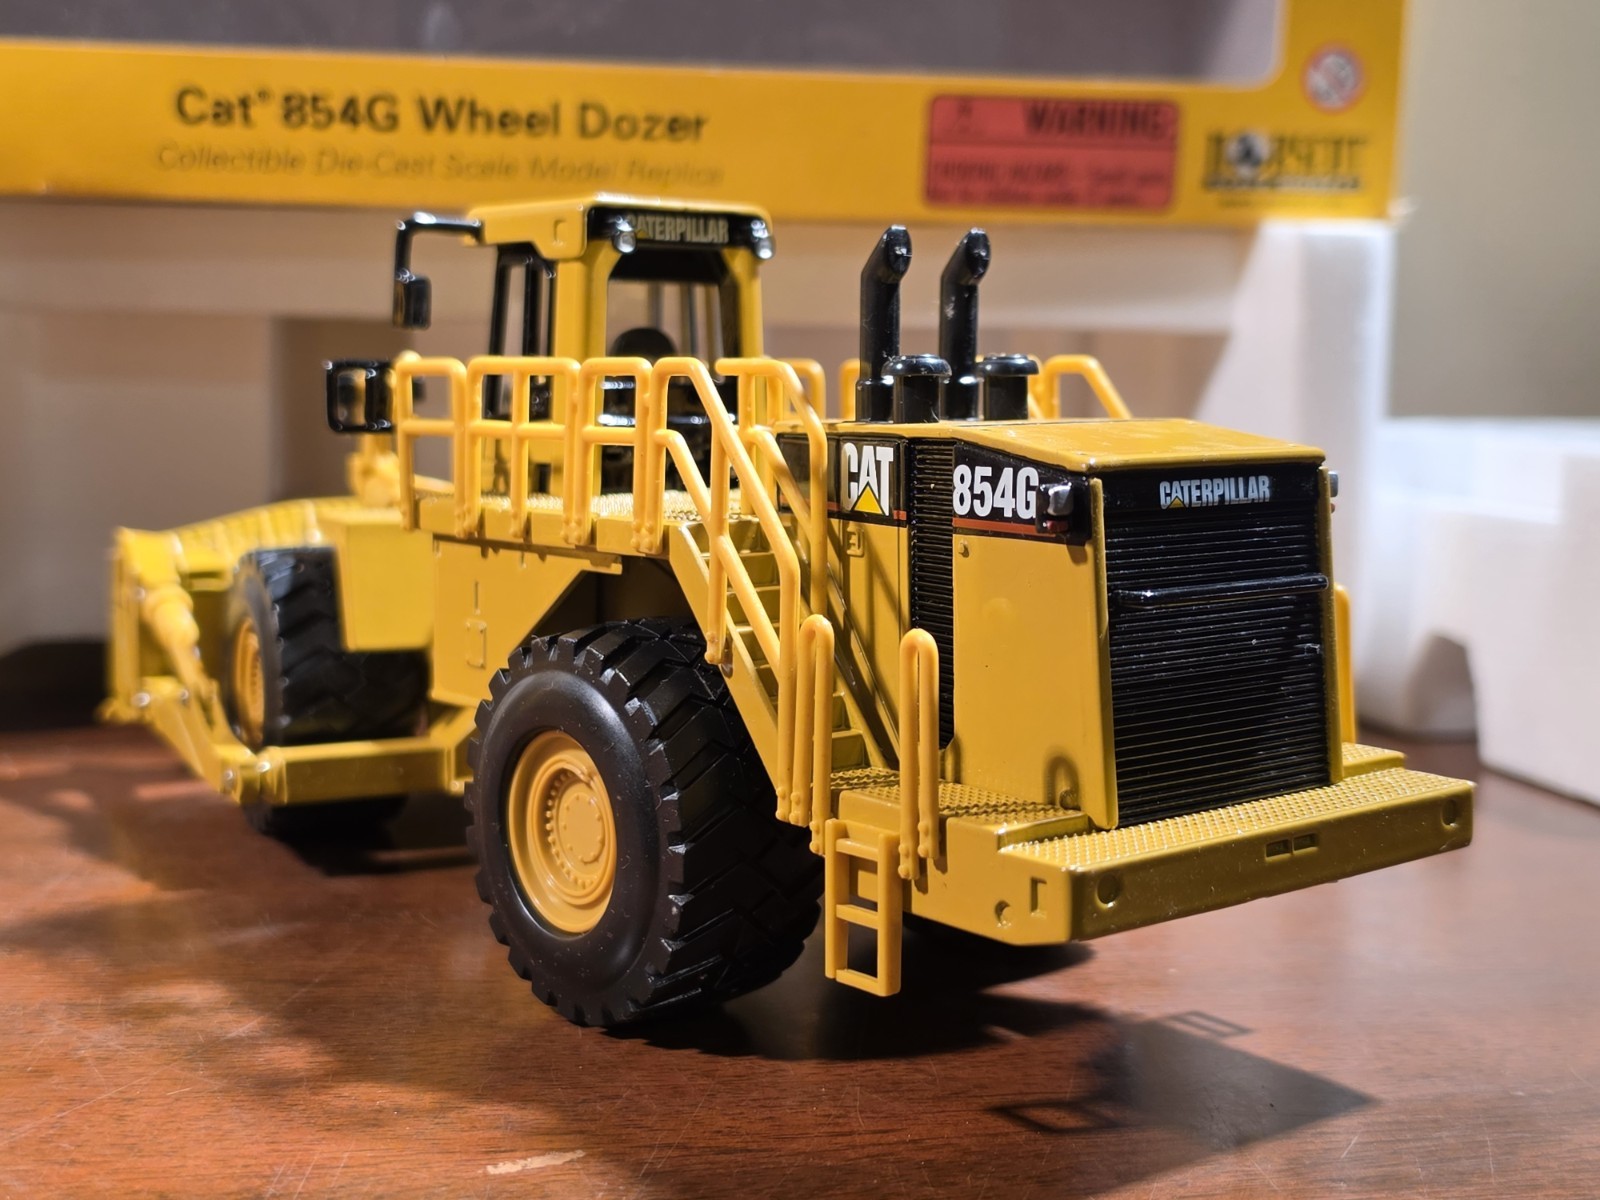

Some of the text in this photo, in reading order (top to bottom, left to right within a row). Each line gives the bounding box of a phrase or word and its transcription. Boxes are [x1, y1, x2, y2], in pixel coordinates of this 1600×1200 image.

[282, 91, 400, 132] 854G
[415, 95, 562, 137] Wheel
[577, 101, 709, 142] Dozer
[1026, 101, 1166, 138] WARNING
[158, 139, 306, 174] Collectible
[445, 153, 519, 182] Scale
[528, 155, 618, 183] Model
[840, 442, 1040, 520] CAT 854G
[1159, 475, 1271, 510] CATERPILLAR
